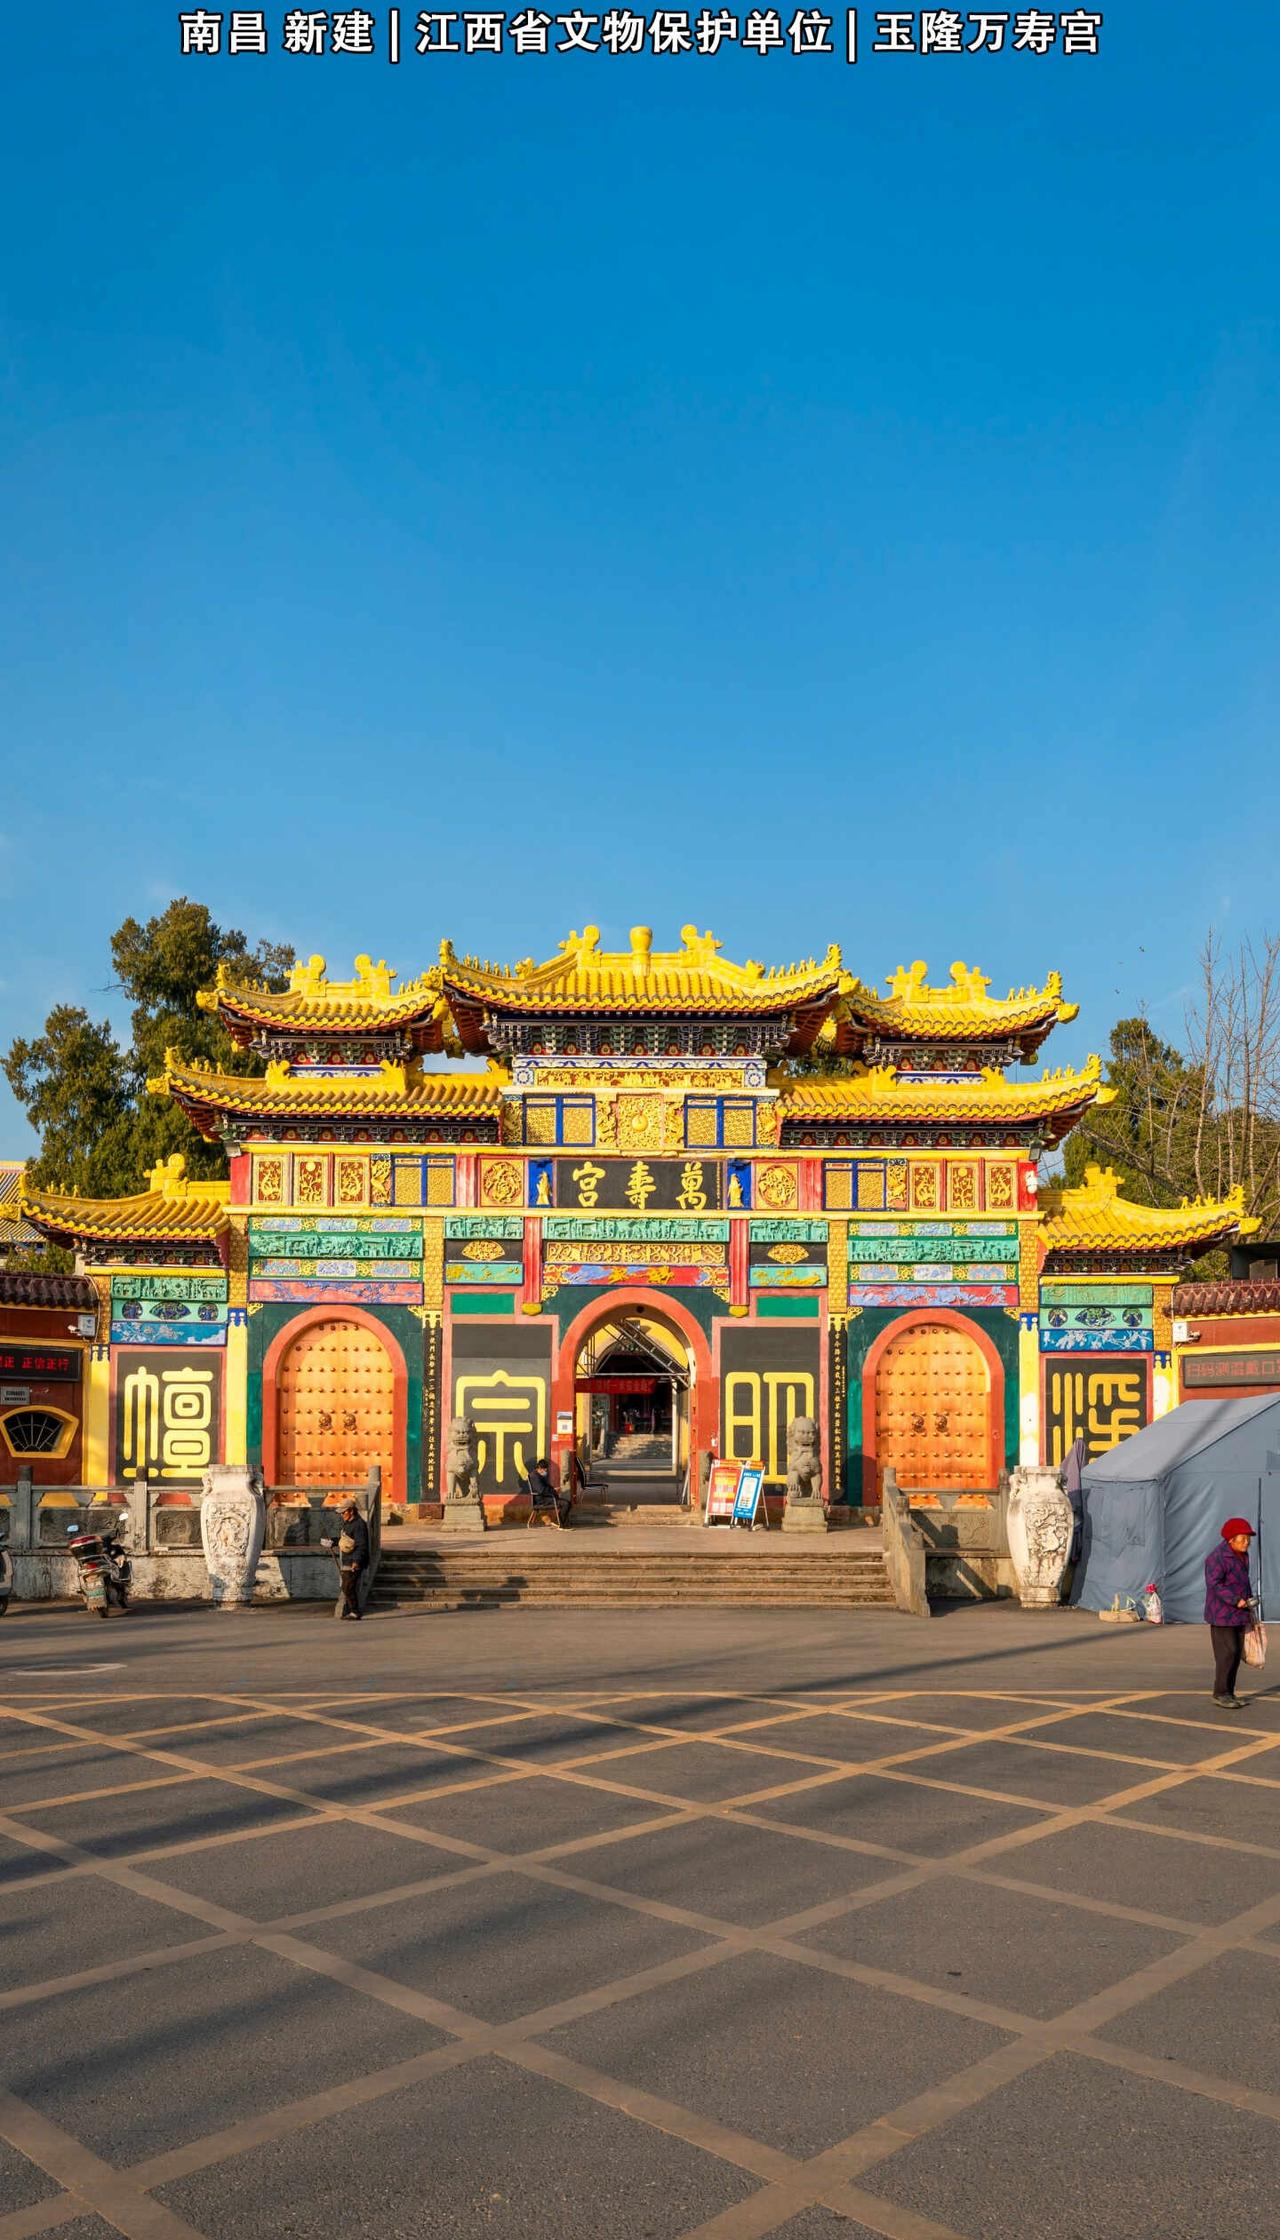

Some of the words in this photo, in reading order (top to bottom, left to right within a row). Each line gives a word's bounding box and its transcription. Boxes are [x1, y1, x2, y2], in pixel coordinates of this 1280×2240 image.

[1187, 1359, 1280, 1377] 扫码测温戴口
